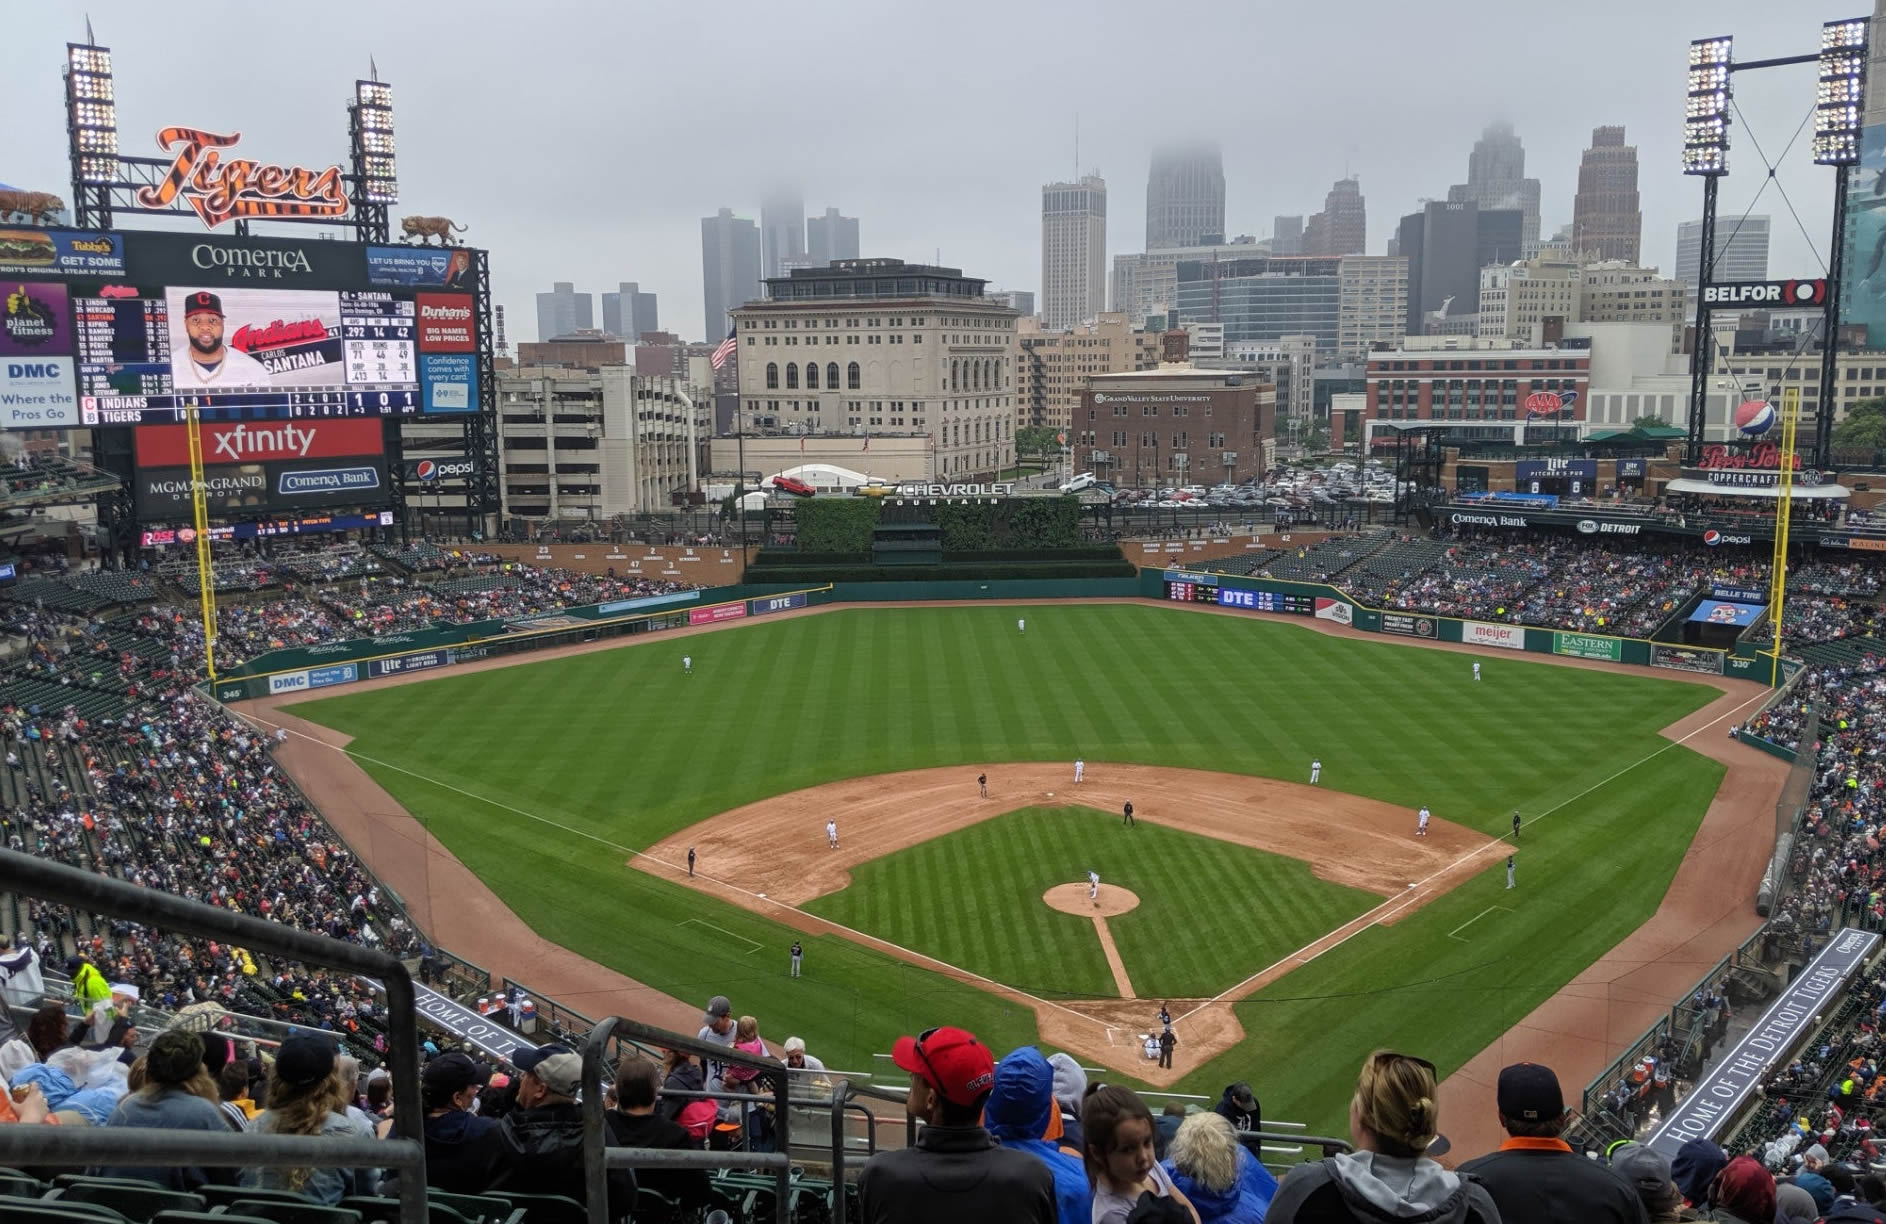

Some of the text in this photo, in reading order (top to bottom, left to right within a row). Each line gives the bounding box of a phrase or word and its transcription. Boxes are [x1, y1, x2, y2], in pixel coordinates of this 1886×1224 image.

[139, 127, 349, 222] Tigers
[71, 241, 112, 253] Tubby's
[60, 256, 122, 267] GET SOME
[227, 268, 282, 278] PARK
[358, 292, 392, 301] SANTANA
[1704, 286, 1781, 302] BELFOR
[421, 306, 470, 318] Dunham's
[6, 318, 46, 329] planet
[12, 326, 54, 336] fitness
[232, 318, 328, 354] Indians
[328, 327, 339, 336] 41
[346, 327, 408, 338] .292 14 42
[261, 349, 286, 360] CARLOS
[353, 350, 408, 360] 71 46 49
[427, 356, 469, 365] Confidence
[264, 350, 326, 374] SANTANA
[8, 364, 60, 378] DMC
[352, 372, 388, 381] .413 14
[428, 374, 449, 383] every
[0, 393, 72, 404] Where the
[85, 398, 94, 410] C
[102, 398, 148, 408] INDIANS
[294, 394, 328, 404] 2 4 0
[355, 392, 412, 407] 1 0 1
[12, 408, 66, 420] Pros Go
[103, 411, 142, 422] TIGERS
[296, 405, 343, 416] 0 2 0 2
[214, 424, 316, 460] xfinity
[438, 461, 474, 477] pepsi
[1547, 458, 1568, 471] Lite
[343, 473, 371, 484] Bank
[1708, 472, 1779, 484] COPPERCRAFT
[150, 476, 262, 494] MGM GRAND
[902, 484, 1015, 496] CHEVROLET
[1500, 516, 1527, 527] Bank
[208, 526, 235, 534] Turnbull
[1582, 522, 1641, 534] FOX DETROIT
[143, 530, 176, 546] ROSE
[1721, 535, 1750, 545] pepsi
[1224, 590, 1254, 606] DTE
[1714, 590, 1762, 600] BELLE TIRE
[770, 598, 791, 610] DTE
[1475, 624, 1512, 639] meijer
[1561, 634, 1614, 649] EASTERN
[412, 654, 438, 662] ORIGINAL
[1732, 660, 1750, 668] 330'
[380, 660, 402, 674] Lite
[274, 676, 306, 689] DMC
[224, 690, 242, 698] 345'
[415, 994, 499, 1041] HOME OF
[1666, 964, 1840, 1142] HOME OF THE DETROIT TIGERS
